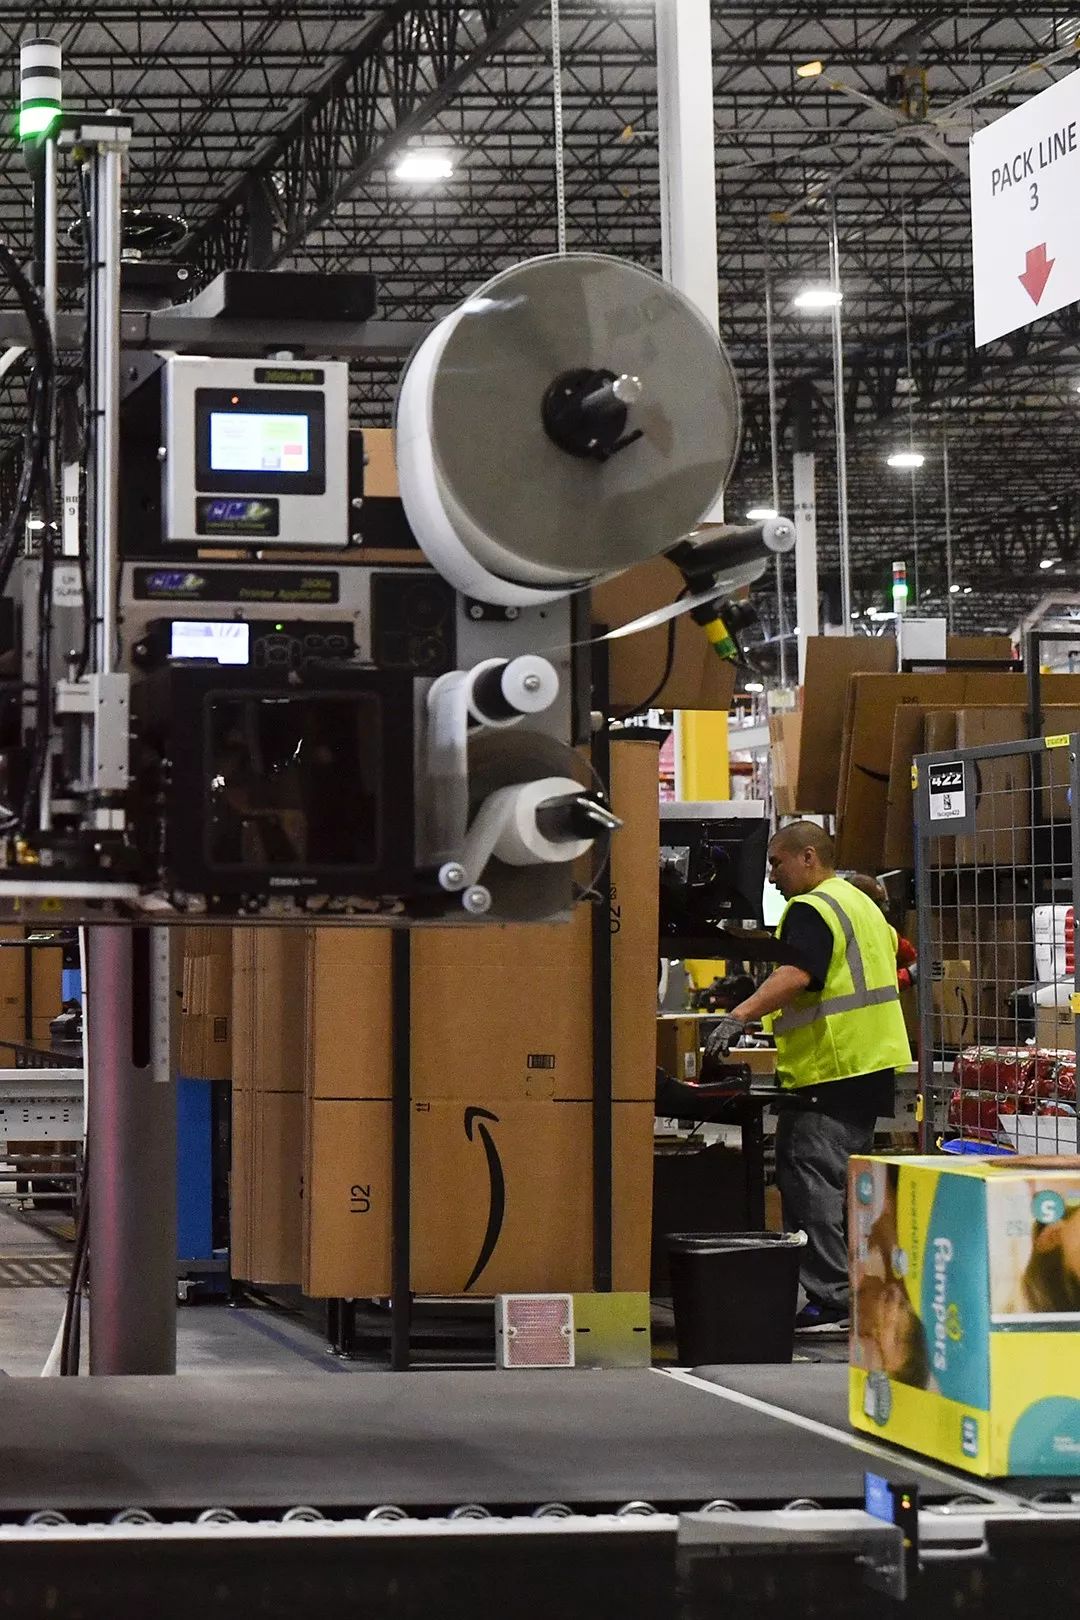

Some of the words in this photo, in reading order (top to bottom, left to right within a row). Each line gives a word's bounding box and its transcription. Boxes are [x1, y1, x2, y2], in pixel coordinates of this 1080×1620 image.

[991, 147, 1034, 196] PACK
[1039, 121, 1078, 169] LINE
[1029, 182, 1040, 212] 3
[68, 506, 76, 516] 9
[931, 772, 962, 787] 422
[350, 1184, 371, 1214] U2
[933, 1236, 953, 1372] Pampers
